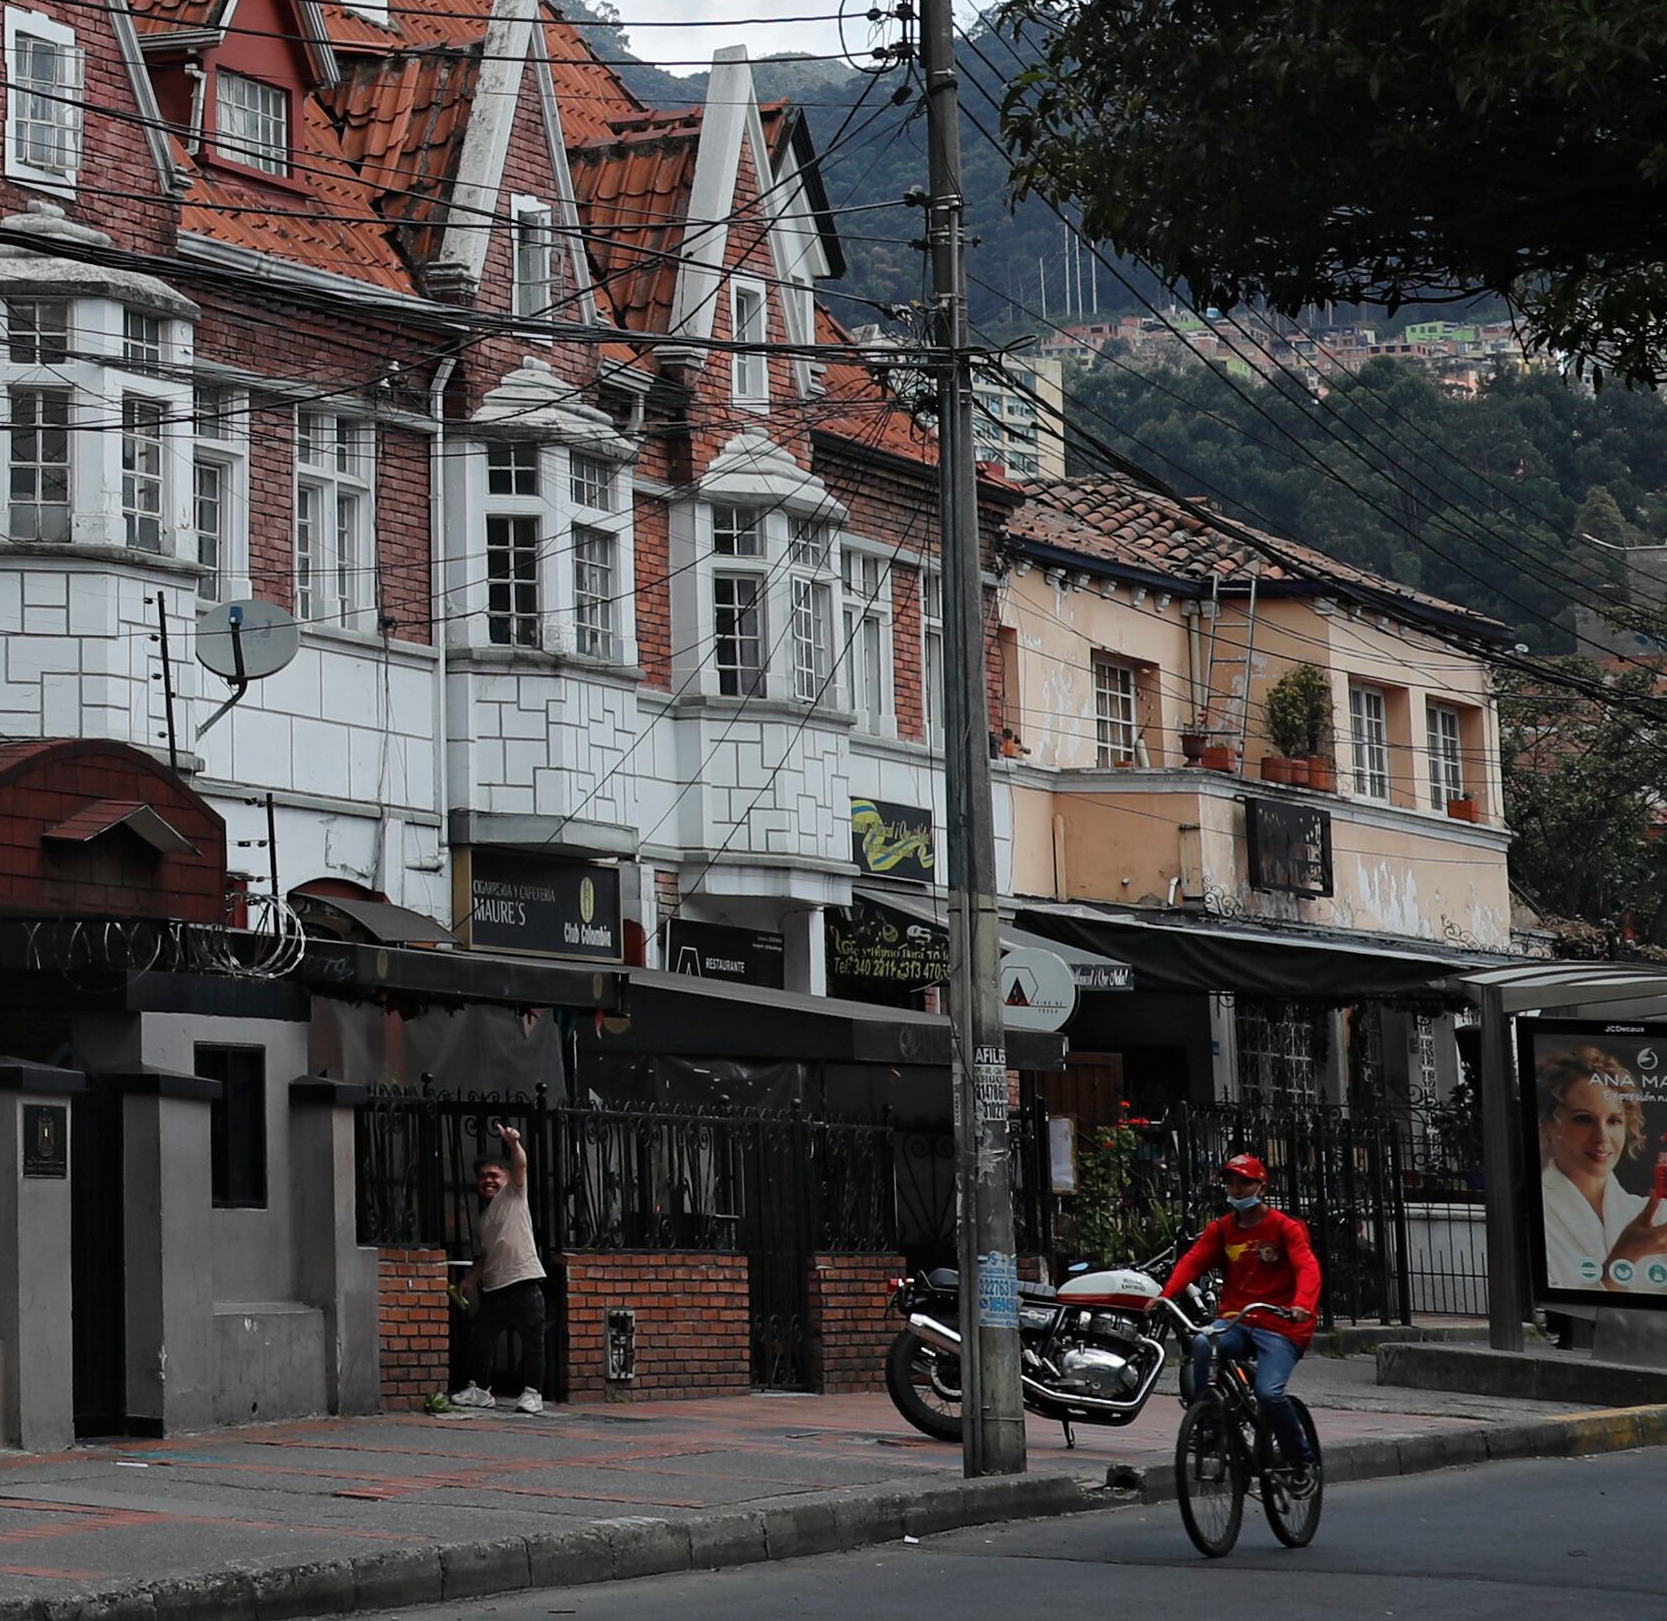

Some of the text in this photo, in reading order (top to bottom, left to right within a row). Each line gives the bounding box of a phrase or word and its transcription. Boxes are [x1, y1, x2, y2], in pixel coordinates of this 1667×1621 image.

[564, 922, 612, 947] Club Colombia
[705, 957, 745, 974] RESTAURANTE
[1605, 1025, 1645, 1033] JCDecaux
[1588, 1072, 1635, 1087] ANA
